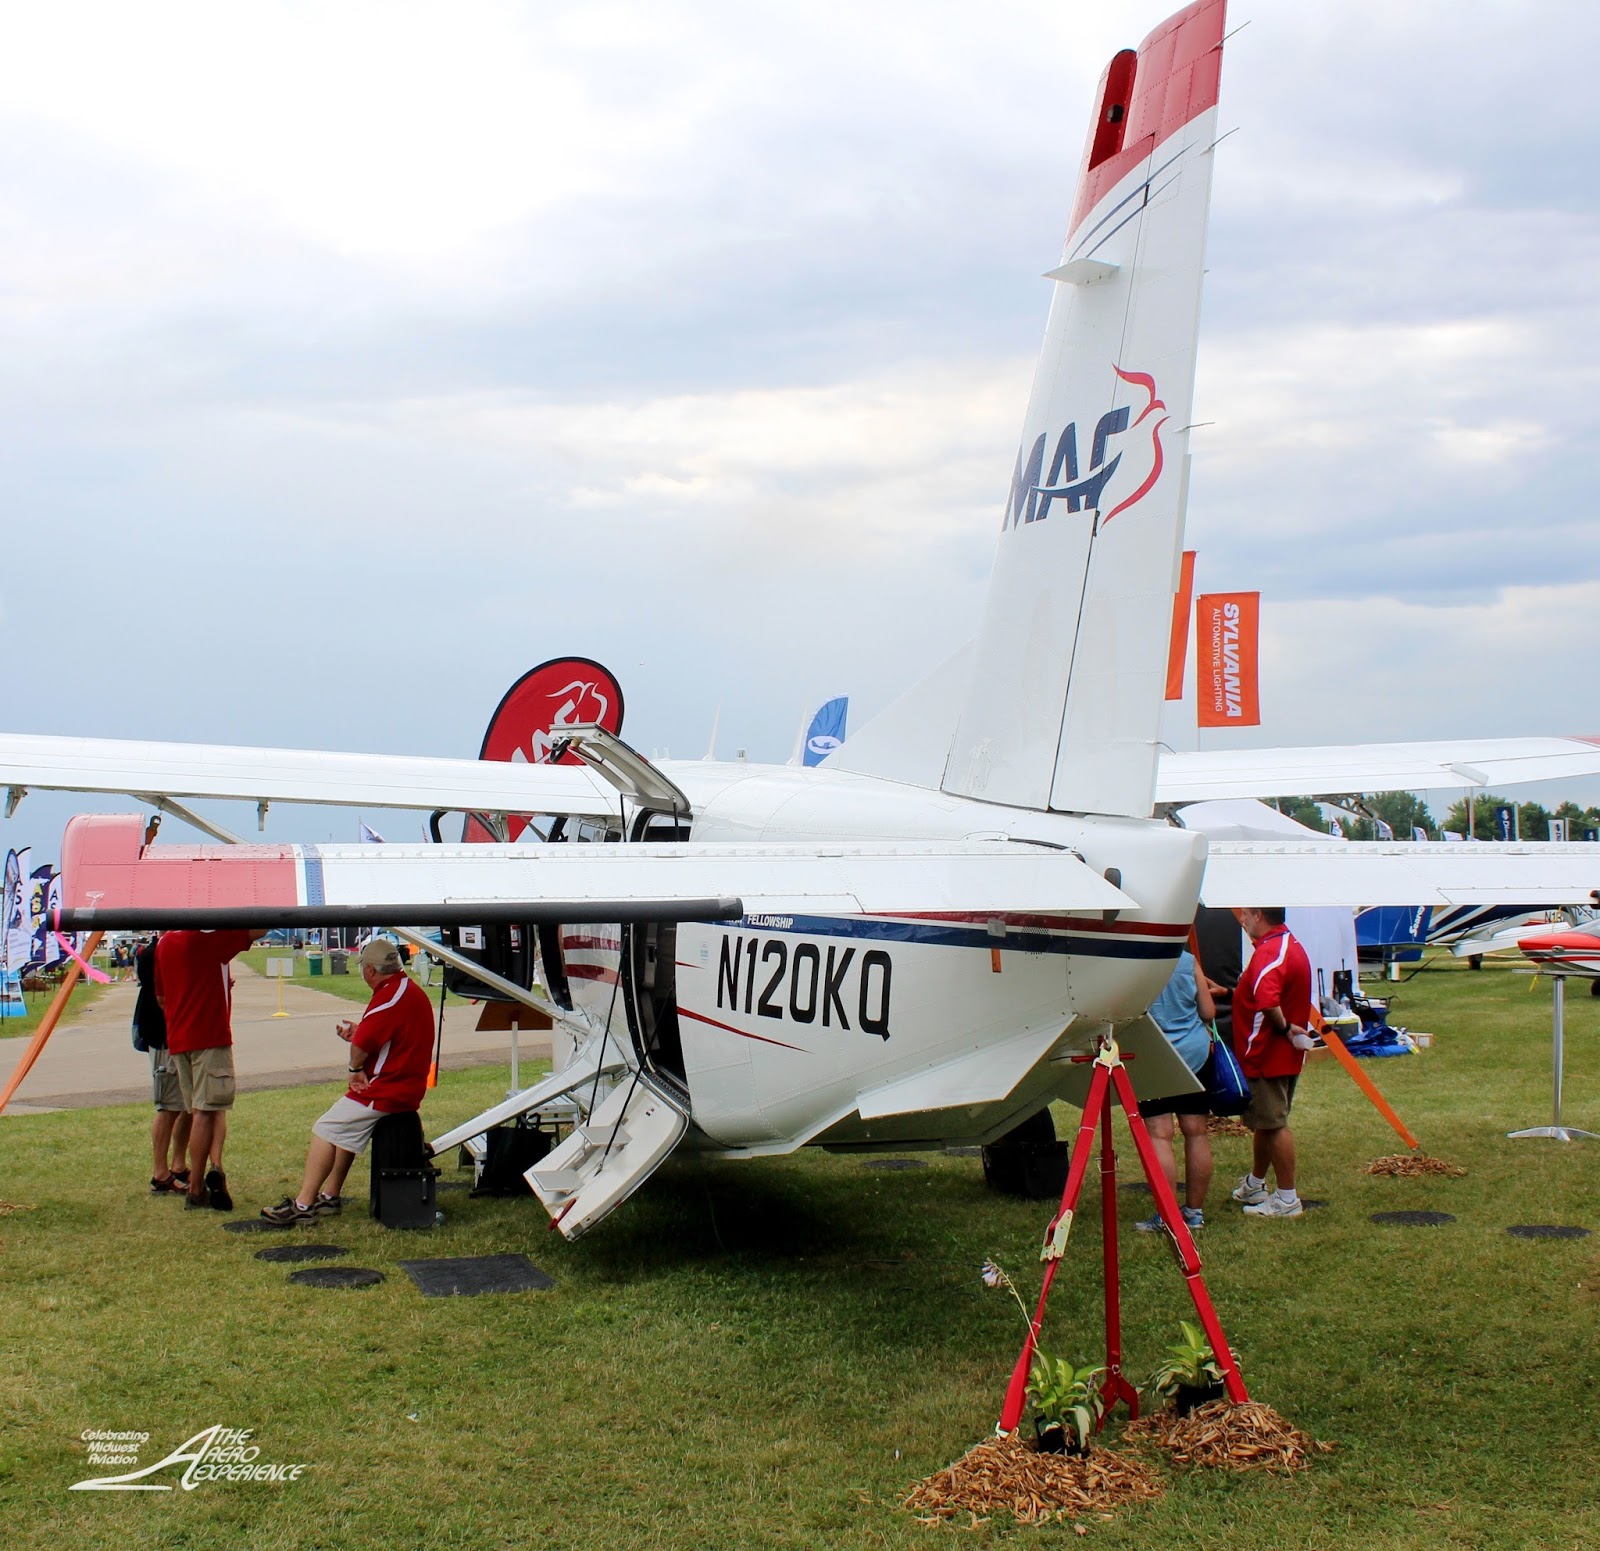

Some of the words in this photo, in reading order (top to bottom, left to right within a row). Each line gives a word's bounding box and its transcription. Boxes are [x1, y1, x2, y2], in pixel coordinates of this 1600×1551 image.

[1000, 405, 1131, 533] MAF
[1212, 608, 1221, 667] AUTOMOTIVE
[1223, 602, 1242, 717] SYLVANIA
[1213, 669, 1223, 712] LIGHTING
[747, 914, 794, 929] FELLOWSHIP
[716, 934, 893, 1042] N120KQ
